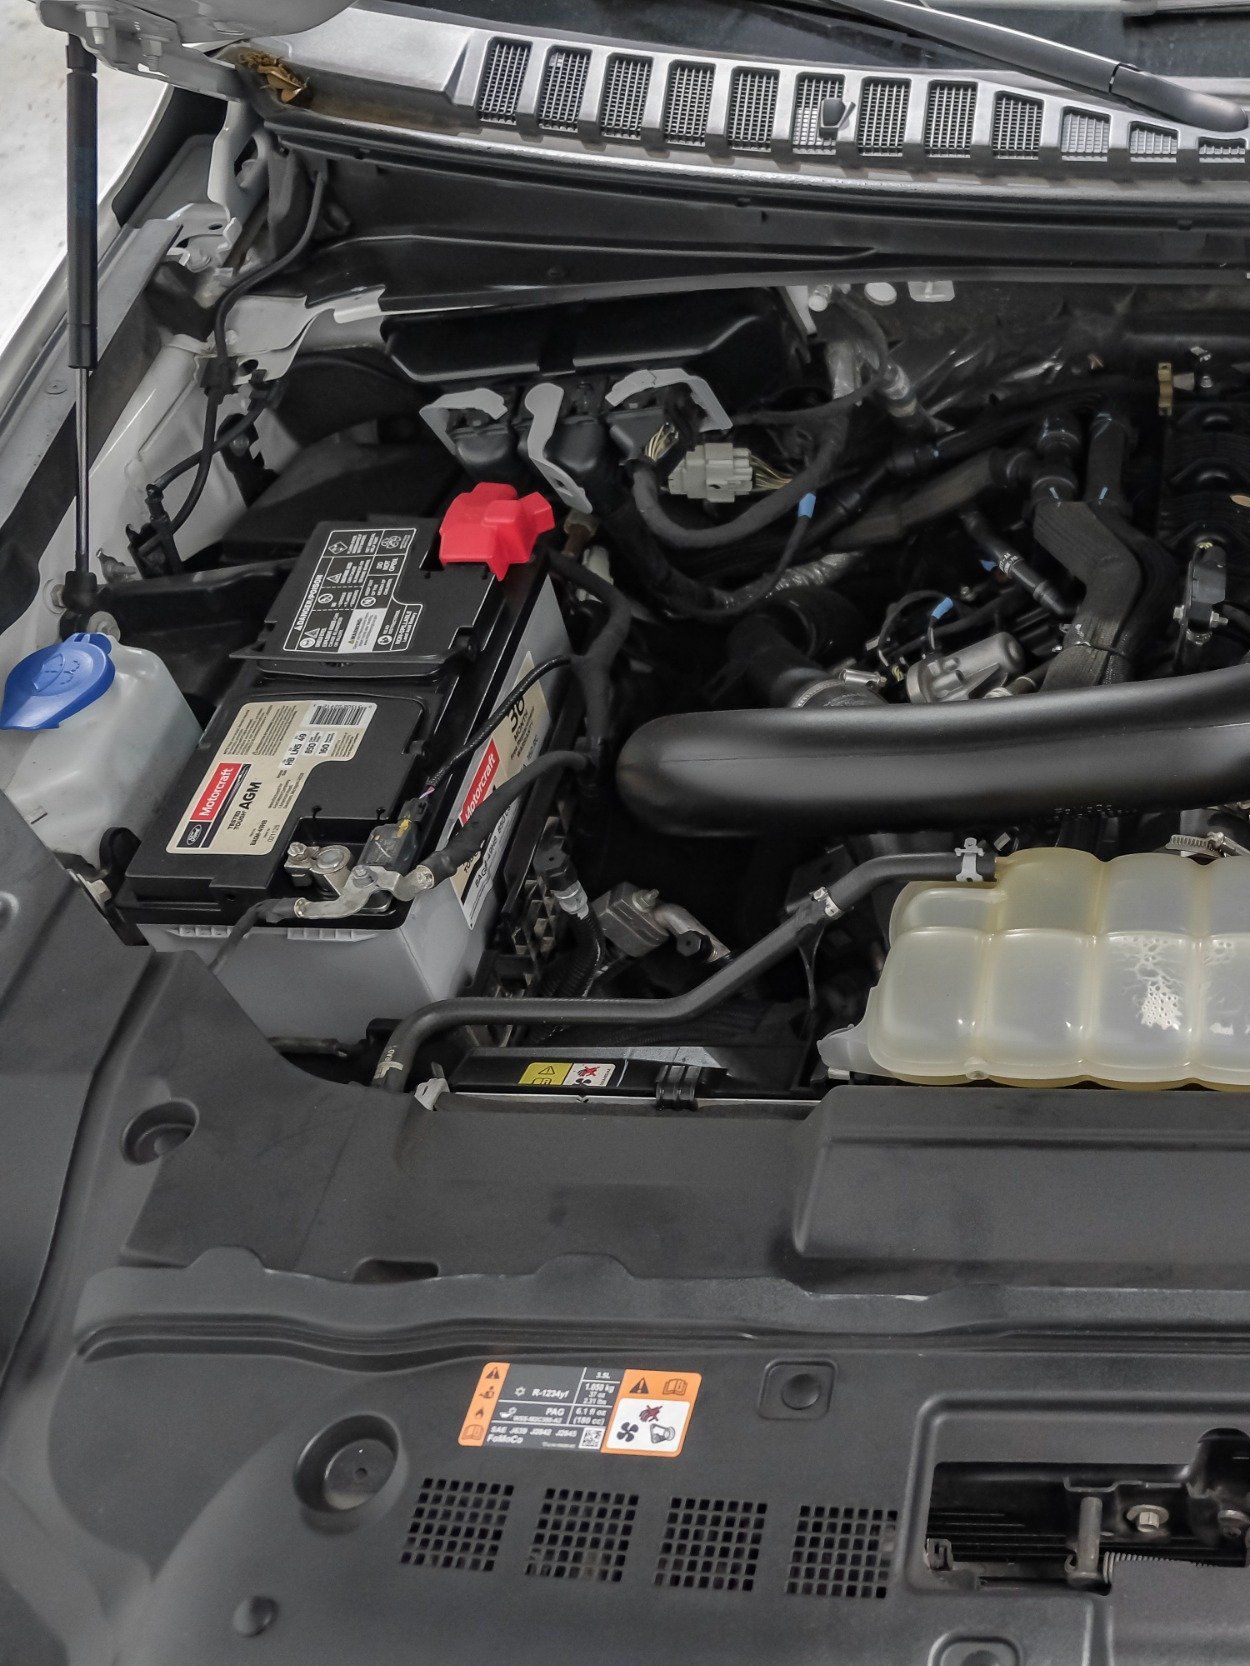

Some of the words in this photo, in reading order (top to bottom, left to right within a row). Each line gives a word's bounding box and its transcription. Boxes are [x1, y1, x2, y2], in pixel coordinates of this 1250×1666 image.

[199, 768, 234, 816] Motorcraft
[238, 781, 263, 810] AGM
[464, 752, 496, 820] Motorcraft
[531, 1388, 570, 1399] R-1234yf
